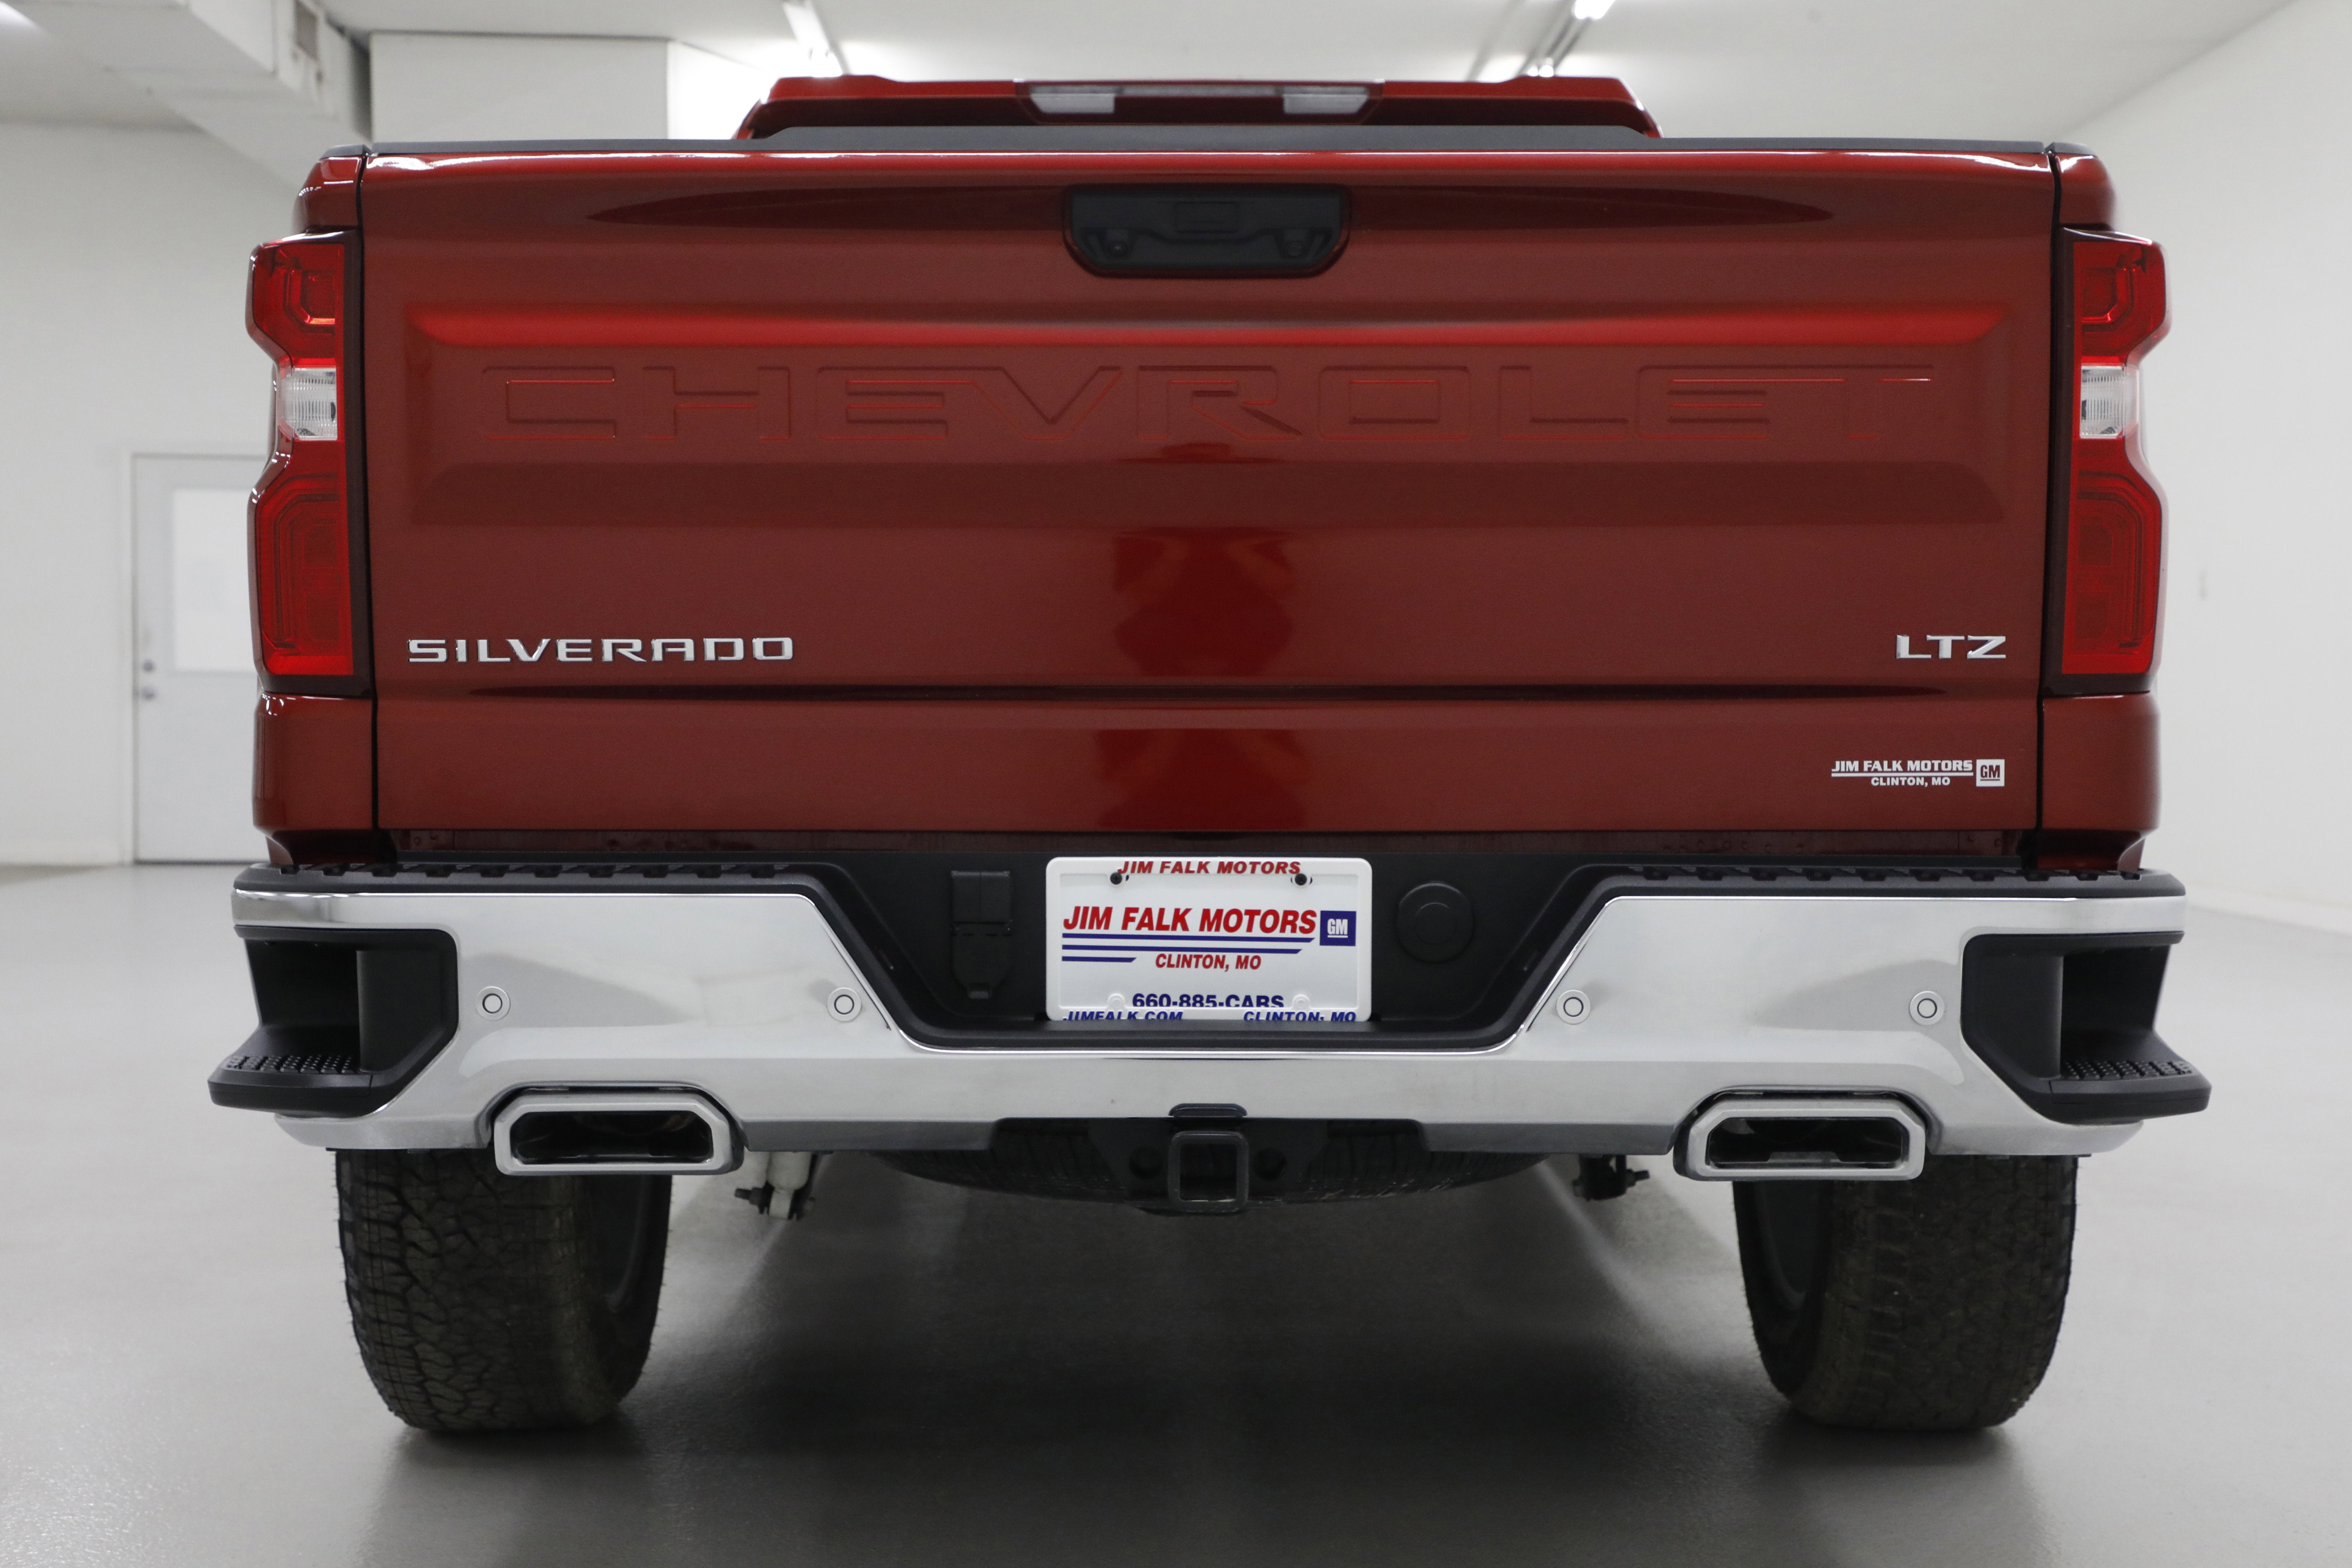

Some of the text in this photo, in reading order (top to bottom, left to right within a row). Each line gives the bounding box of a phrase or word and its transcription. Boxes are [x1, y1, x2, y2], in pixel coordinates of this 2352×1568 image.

[482, 365, 1934, 440] CHEVROLET
[408, 637, 792, 662] SILVERADO
[1897, 635, 2006, 658] LTZ
[1832, 760, 1972, 771] JIM FALK MOTORS
[1980, 765, 2000, 777] GM
[1871, 777, 1950, 787] CLINTON, MO
[1118, 861, 1301, 874] JIM FALK MOTORS
[1063, 906, 1316, 934] JIM FALK MOTORS
[1327, 919, 1348, 935] GM
[1156, 953, 1261, 971] CLINTON, MO
[1133, 993, 1283, 1007] 660-885-CARS
[1064, 1011, 1183, 1020] JIMFALKCOM
[1332, 1012, 1356, 1022] MO
